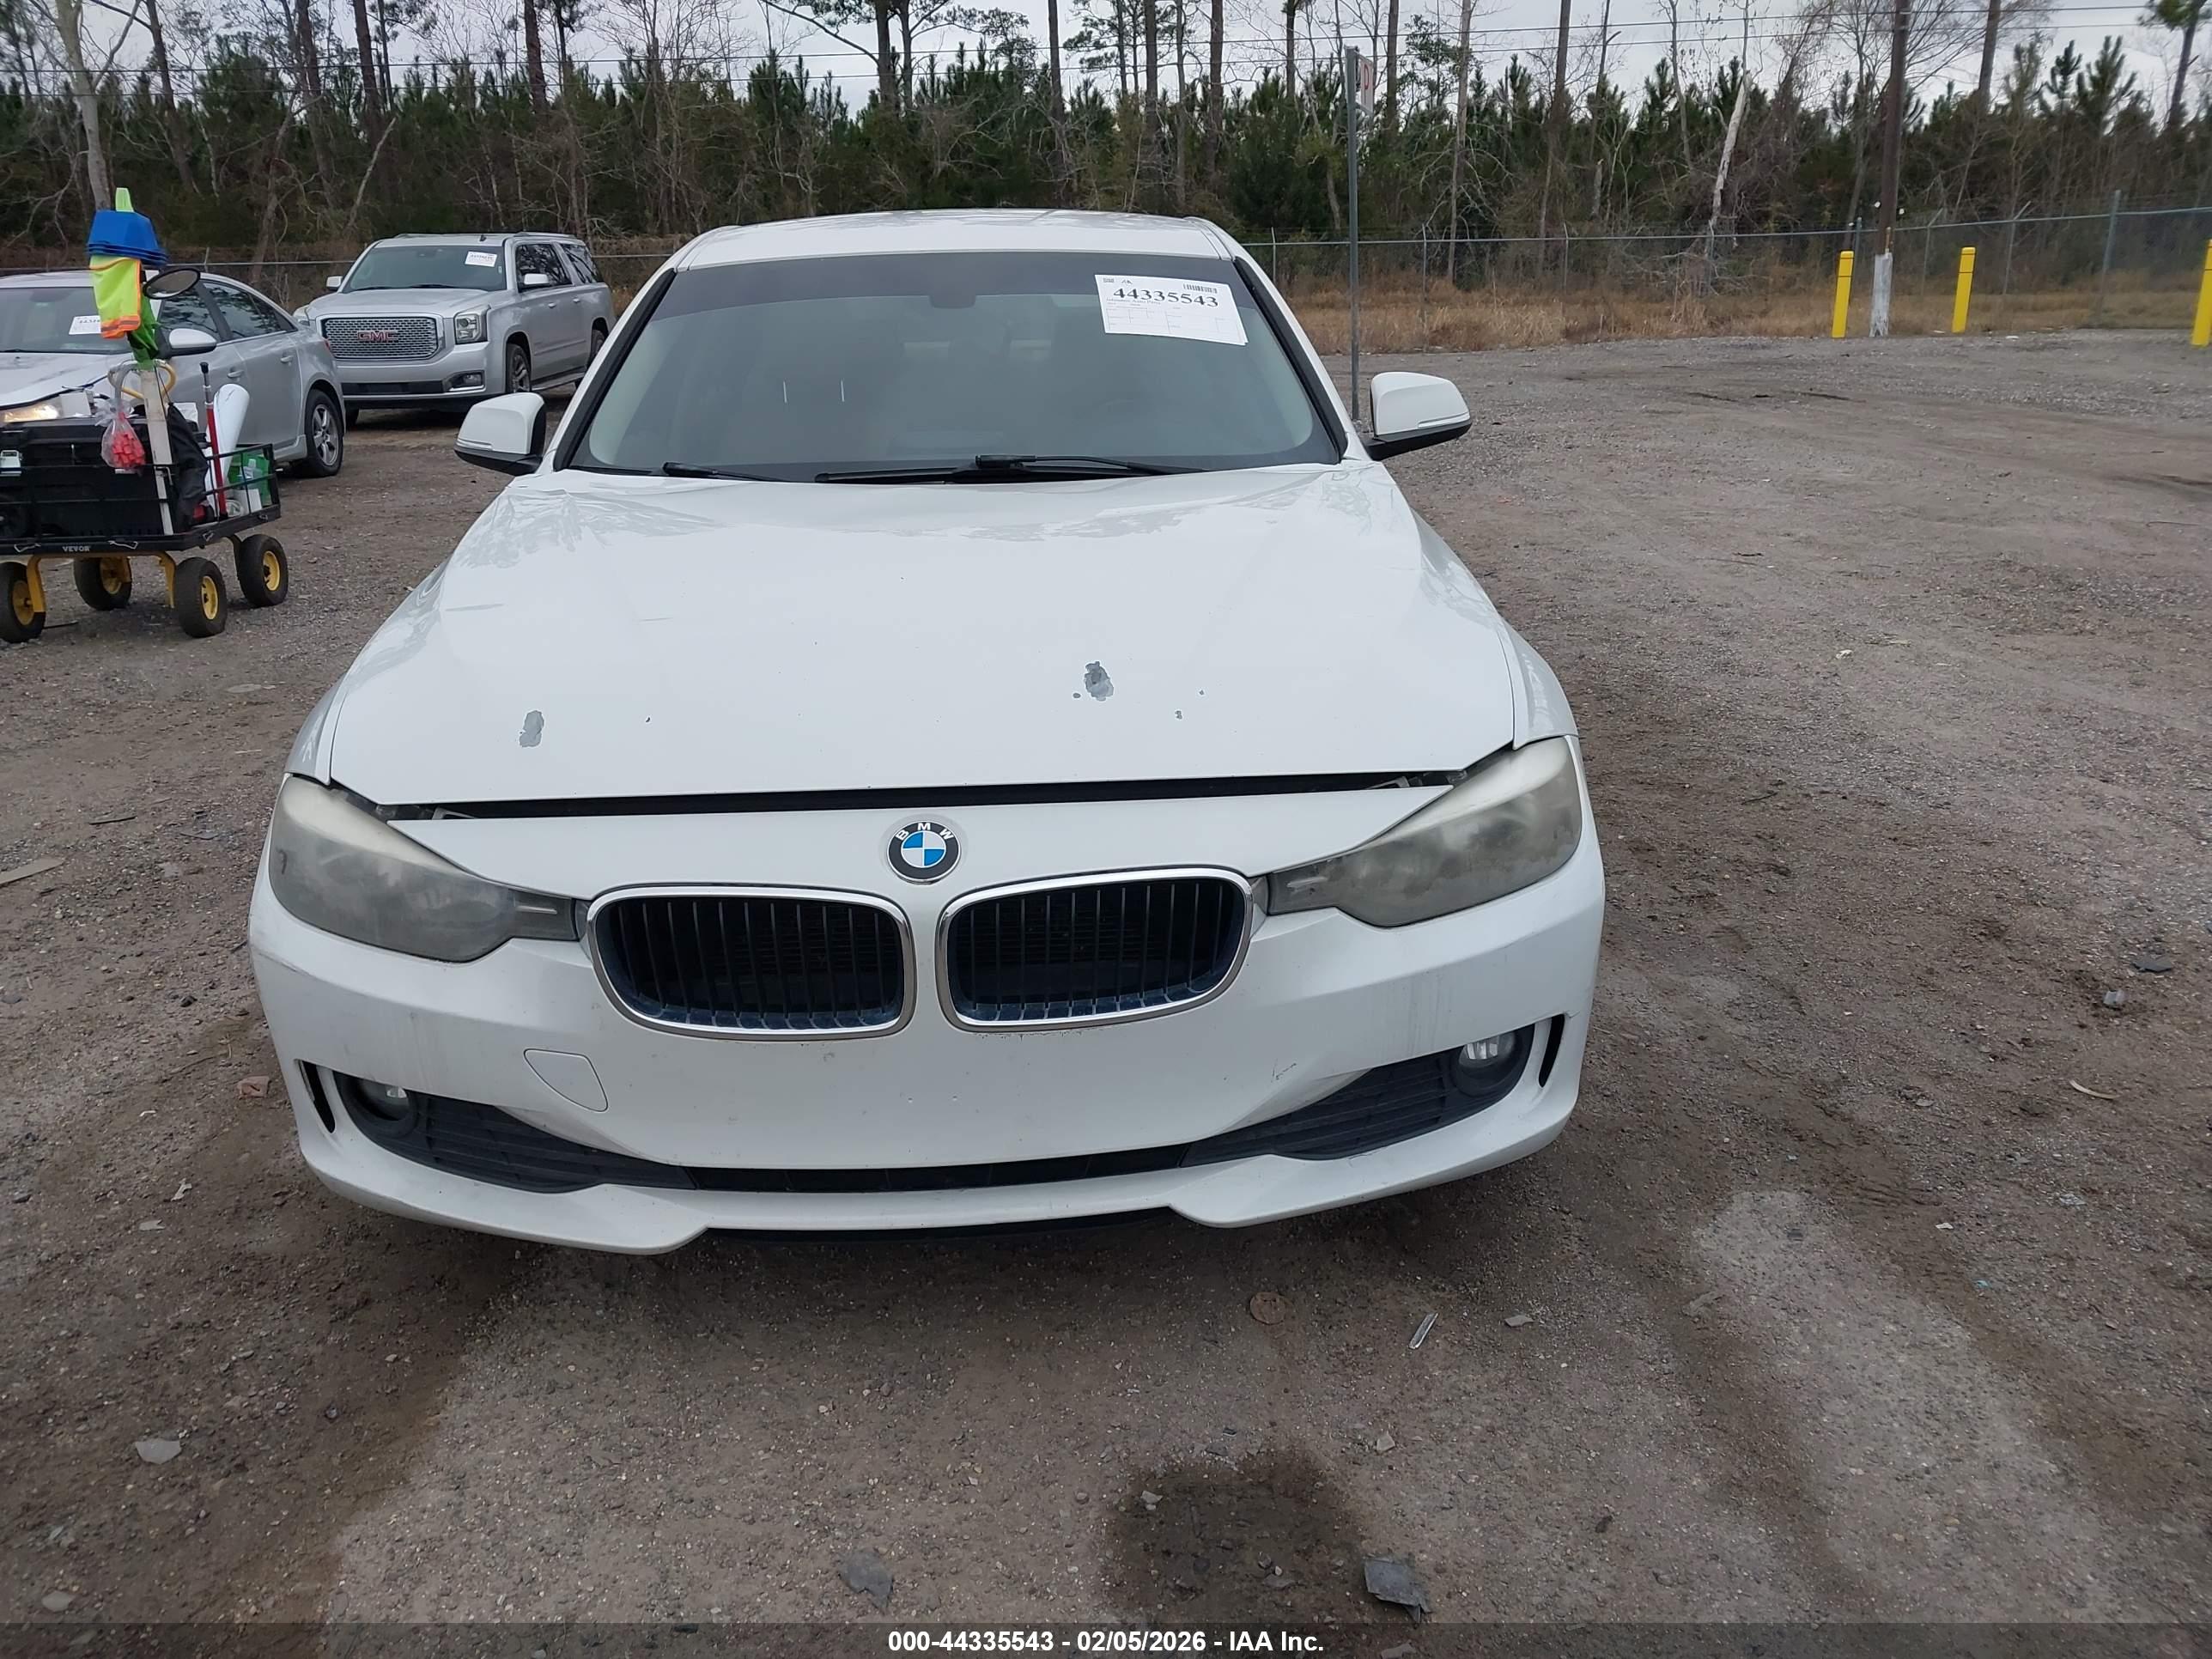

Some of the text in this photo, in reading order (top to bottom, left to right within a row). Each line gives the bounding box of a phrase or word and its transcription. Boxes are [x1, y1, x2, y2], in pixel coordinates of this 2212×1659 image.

[1113, 288, 1218, 307] 44335543
[357, 330, 398, 342] GMC
[895, 822, 955, 842] BMW
